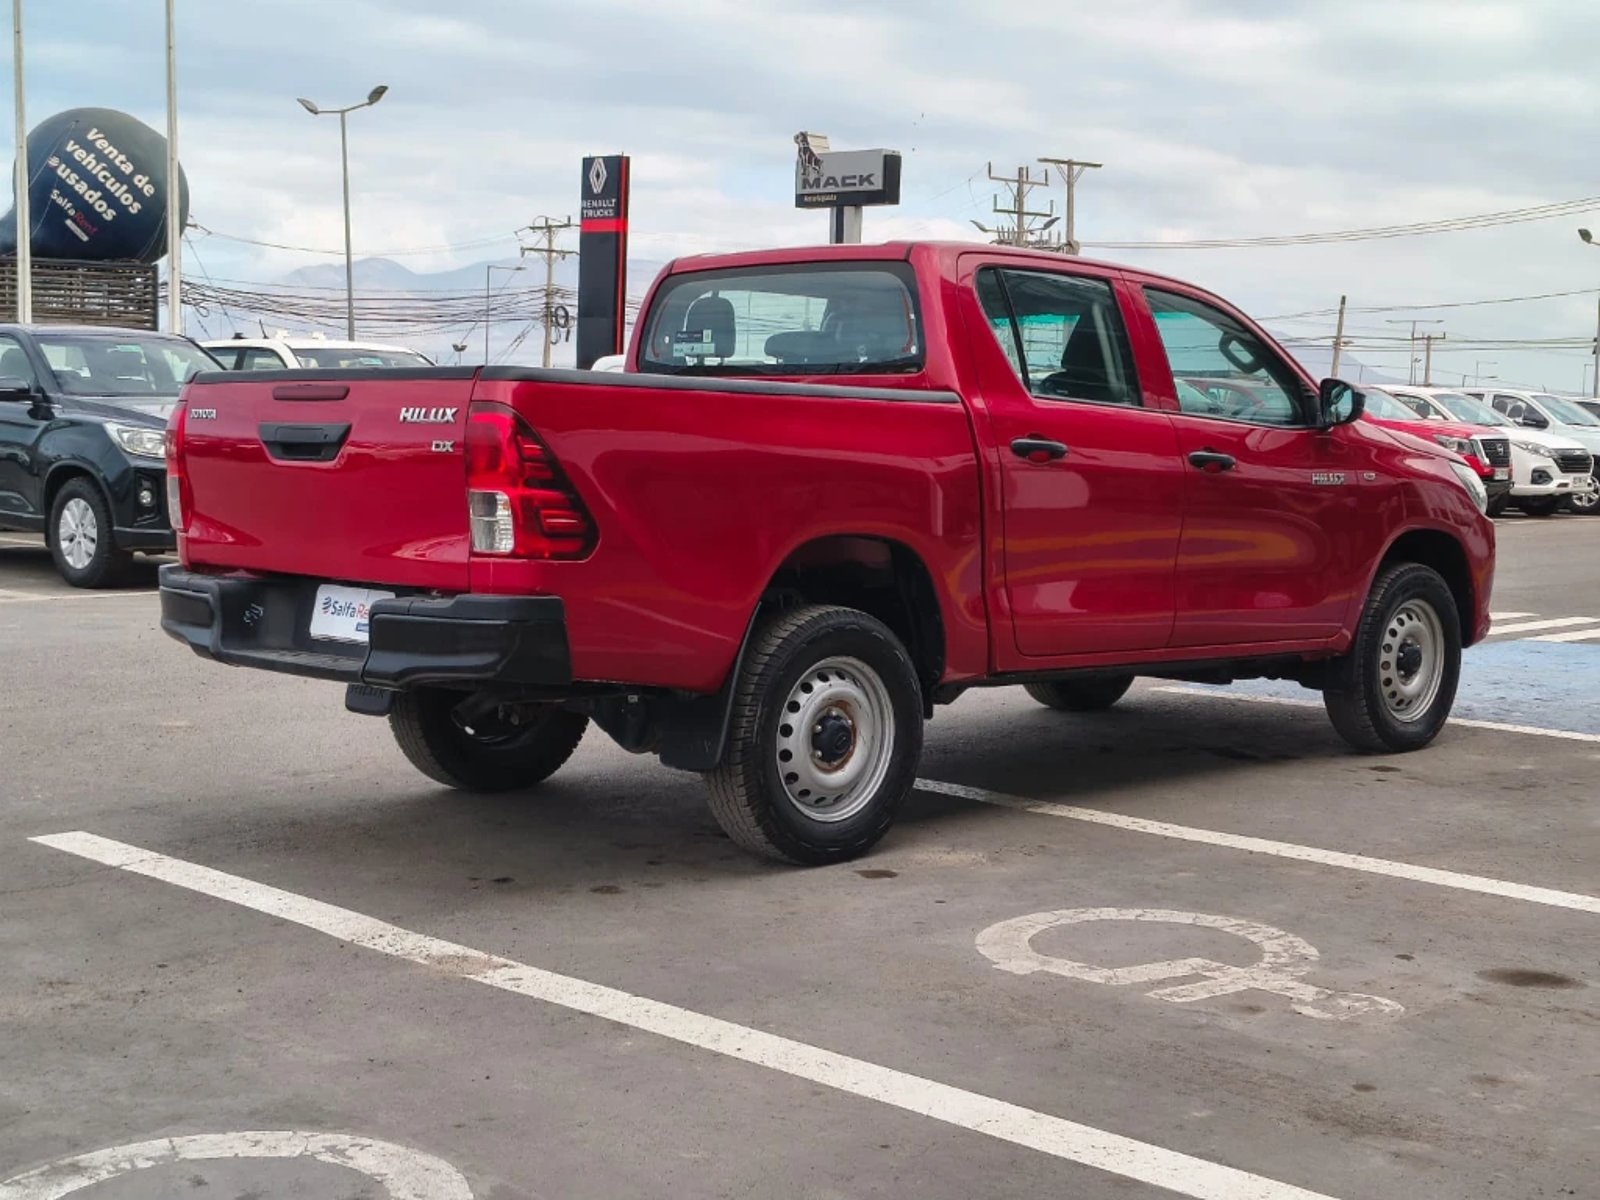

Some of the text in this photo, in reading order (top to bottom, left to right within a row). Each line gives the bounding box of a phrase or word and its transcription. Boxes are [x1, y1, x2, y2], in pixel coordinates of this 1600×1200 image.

[86, 128, 155, 197] Venta de
[65, 140, 143, 214] vehículos
[801, 173, 875, 190] MACK
[56, 162, 117, 221] usados
[583, 209, 614, 217] TRUCKS
[400, 407, 458, 423] HILUX
[432, 440, 455, 452] DX
[331, 600, 369, 619] SalfaRe
